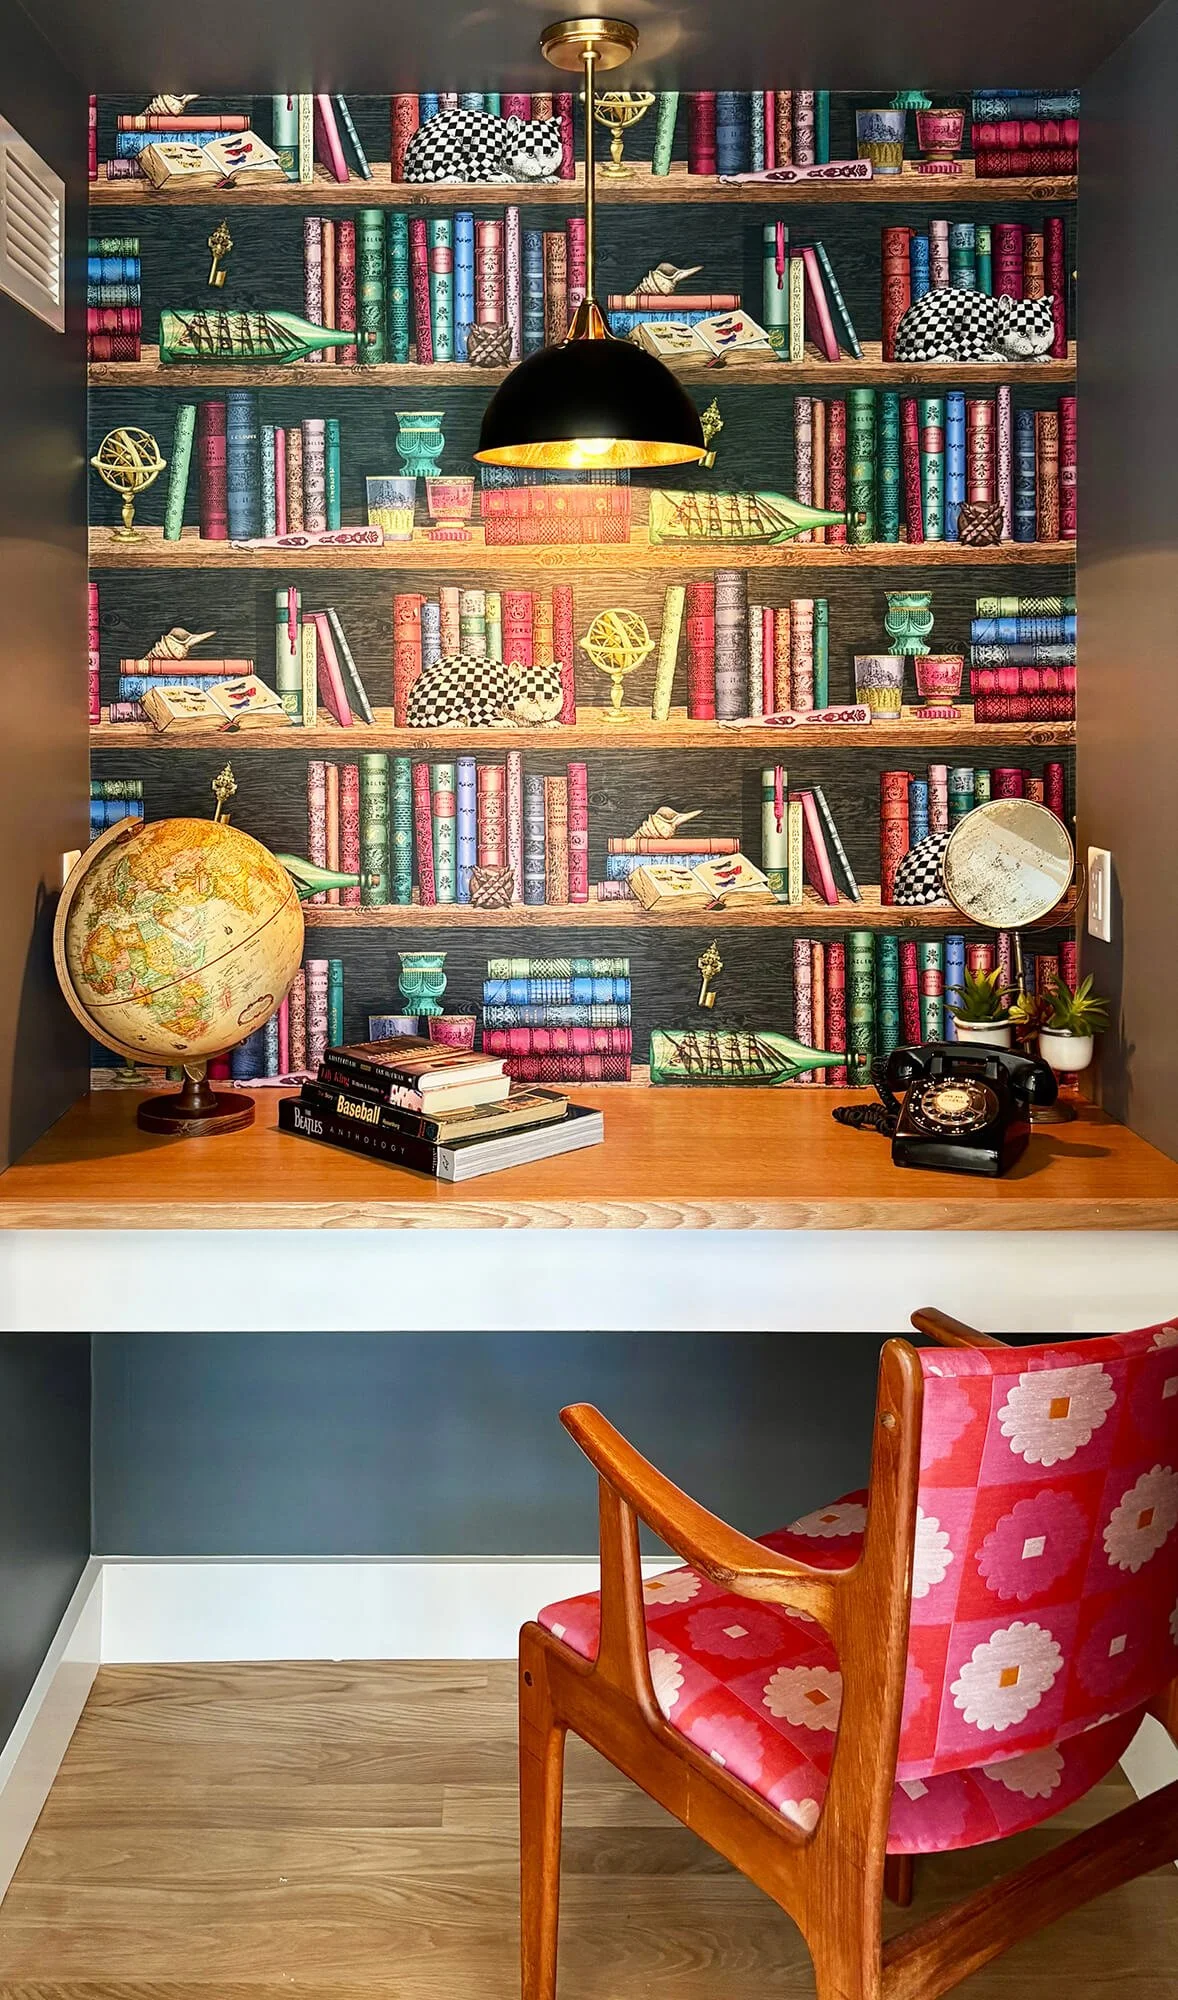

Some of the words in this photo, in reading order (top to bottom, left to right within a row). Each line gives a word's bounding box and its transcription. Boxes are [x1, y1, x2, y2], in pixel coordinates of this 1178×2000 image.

[336, 1094, 381, 1125] Baseball
[294, 1106, 323, 1135] BEATLES
[329, 1126, 405, 1155] ANTHOLOGY
